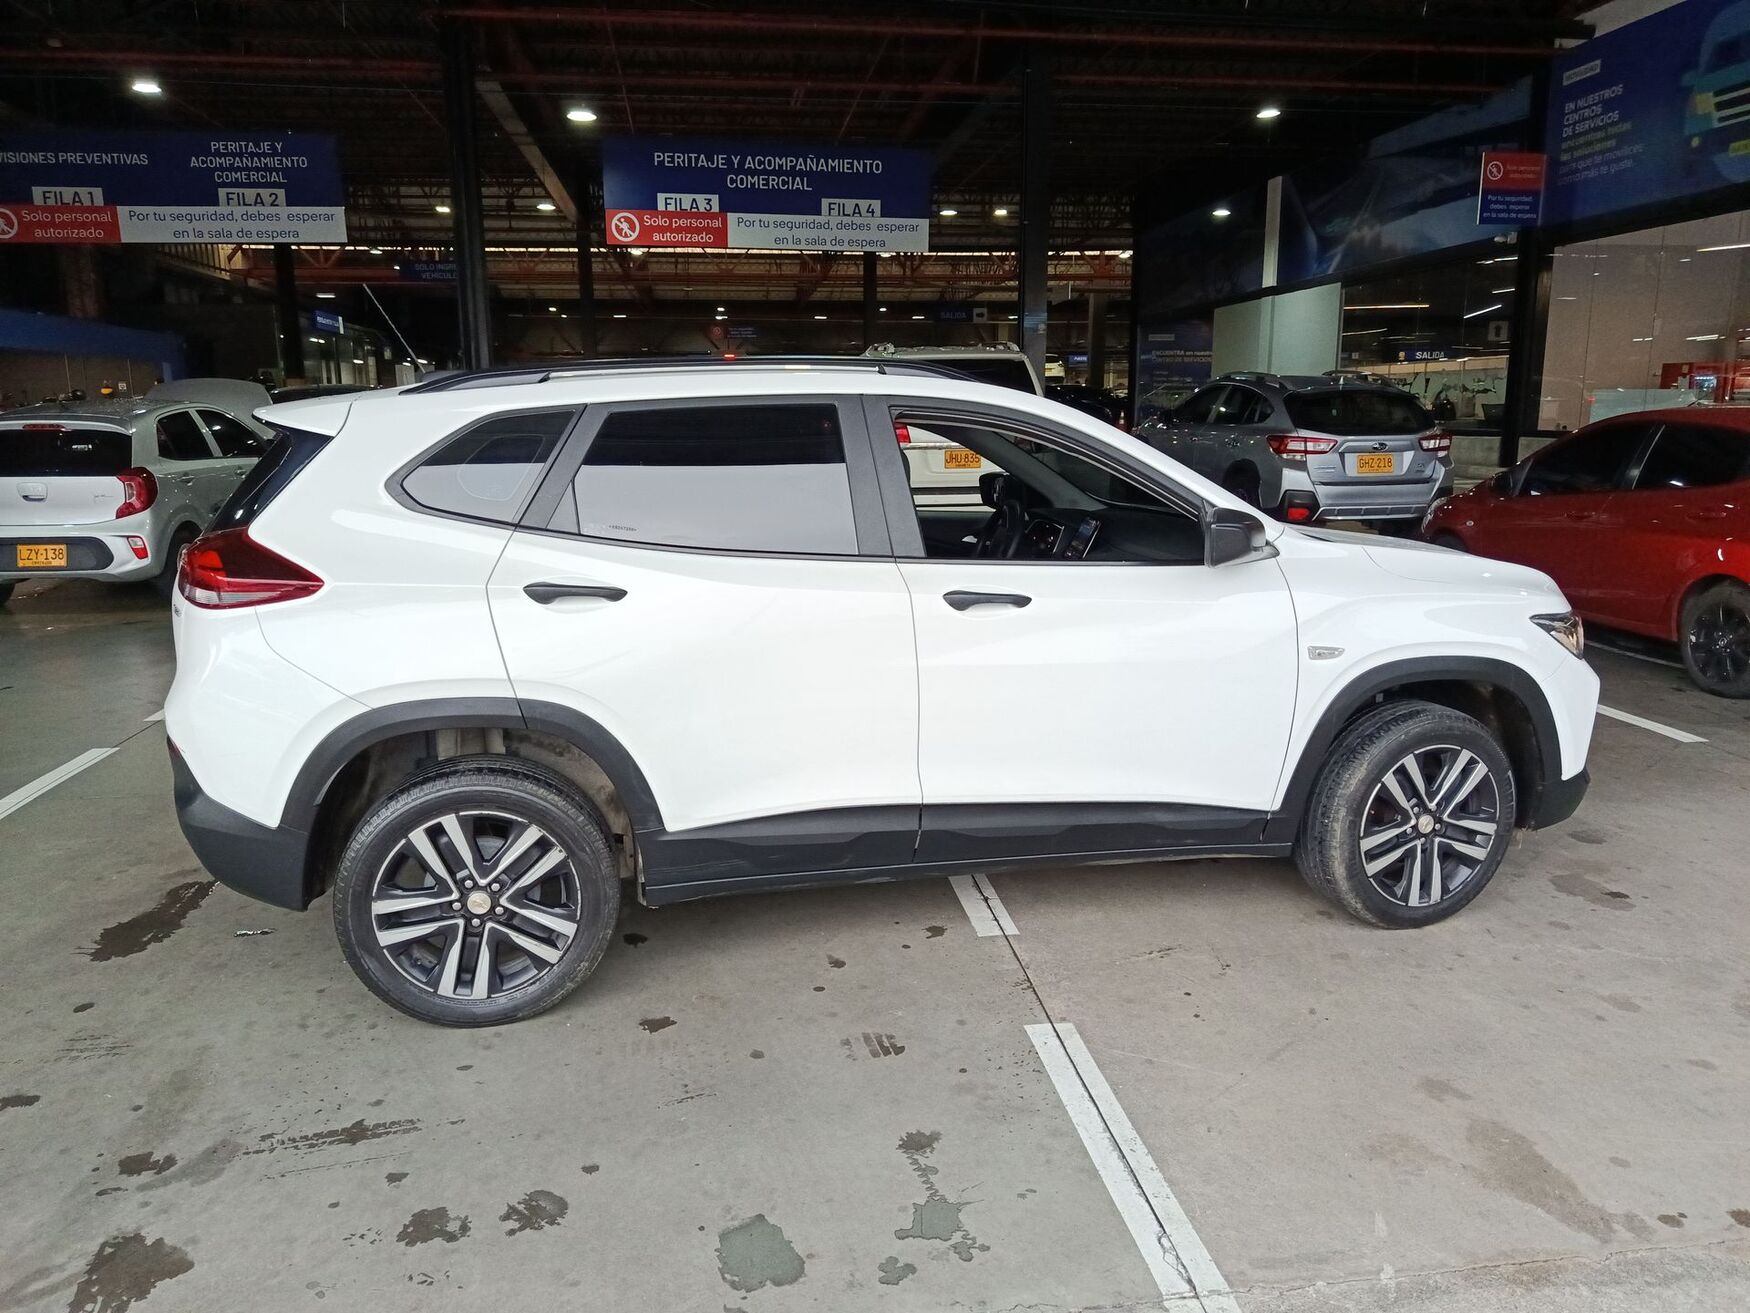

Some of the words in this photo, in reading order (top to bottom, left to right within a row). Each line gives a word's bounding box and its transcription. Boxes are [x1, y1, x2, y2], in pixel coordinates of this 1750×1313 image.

[1565, 101, 1575, 113] EN
[1576, 84, 1624, 109] NUESTROS
[1563, 104, 1602, 125] CENTROS
[1562, 125, 1573, 137] DE
[1574, 110, 1619, 134] SERVICIOS
[211, 142, 272, 153] PERITAJE
[276, 142, 282, 153] Y
[58, 152, 149, 165] PREVENTIVAS
[190, 154, 308, 168] ACOMPAÑAMIENTO
[654, 152, 727, 168] PERITAJE
[731, 155, 740, 168] Y
[745, 154, 882, 174] ACOMPAÑAMIENTO
[214, 171, 288, 183] COMERCIAL
[727, 174, 813, 191] COMERCIAL
[42, 191, 84, 205] FILA
[88, 192, 95, 205] 1
[226, 192, 265, 206] FILA
[269, 192, 279, 206] 2
[664, 197, 700, 211] FILA
[704, 198, 712, 211] 3
[828, 202, 863, 216] FILA
[866, 203, 875, 216] 4
[22, 210, 51, 222] Solo
[55, 211, 112, 224] personal
[129, 210, 149, 222] Por
[153, 211, 166, 222] tu
[169, 210, 238, 224] seguridad,
[241, 210, 280, 222] debes
[287, 212, 335, 224] esperar
[643, 215, 669, 226] Solo
[672, 216, 722, 228] personal
[34, 227, 104, 238] autorizado
[737, 217, 755, 228] Por
[759, 218, 770, 228] tu
[773, 218, 833, 231] seguridad,
[836, 220, 871, 231] debes
[877, 223, 919, 234] esperar
[173, 230, 189, 238] en
[193, 228, 204, 238] la
[207, 228, 233, 239] sala
[236, 228, 252, 239] de
[256, 230, 299, 240] espera
[653, 231, 714, 242] autorizado
[774, 237, 789, 245] en
[792, 235, 801, 246] la
[804, 235, 827, 246] sala
[830, 236, 844, 247] de
[847, 238, 886, 249] espera
[1415, 351, 1445, 360] SALIDA
